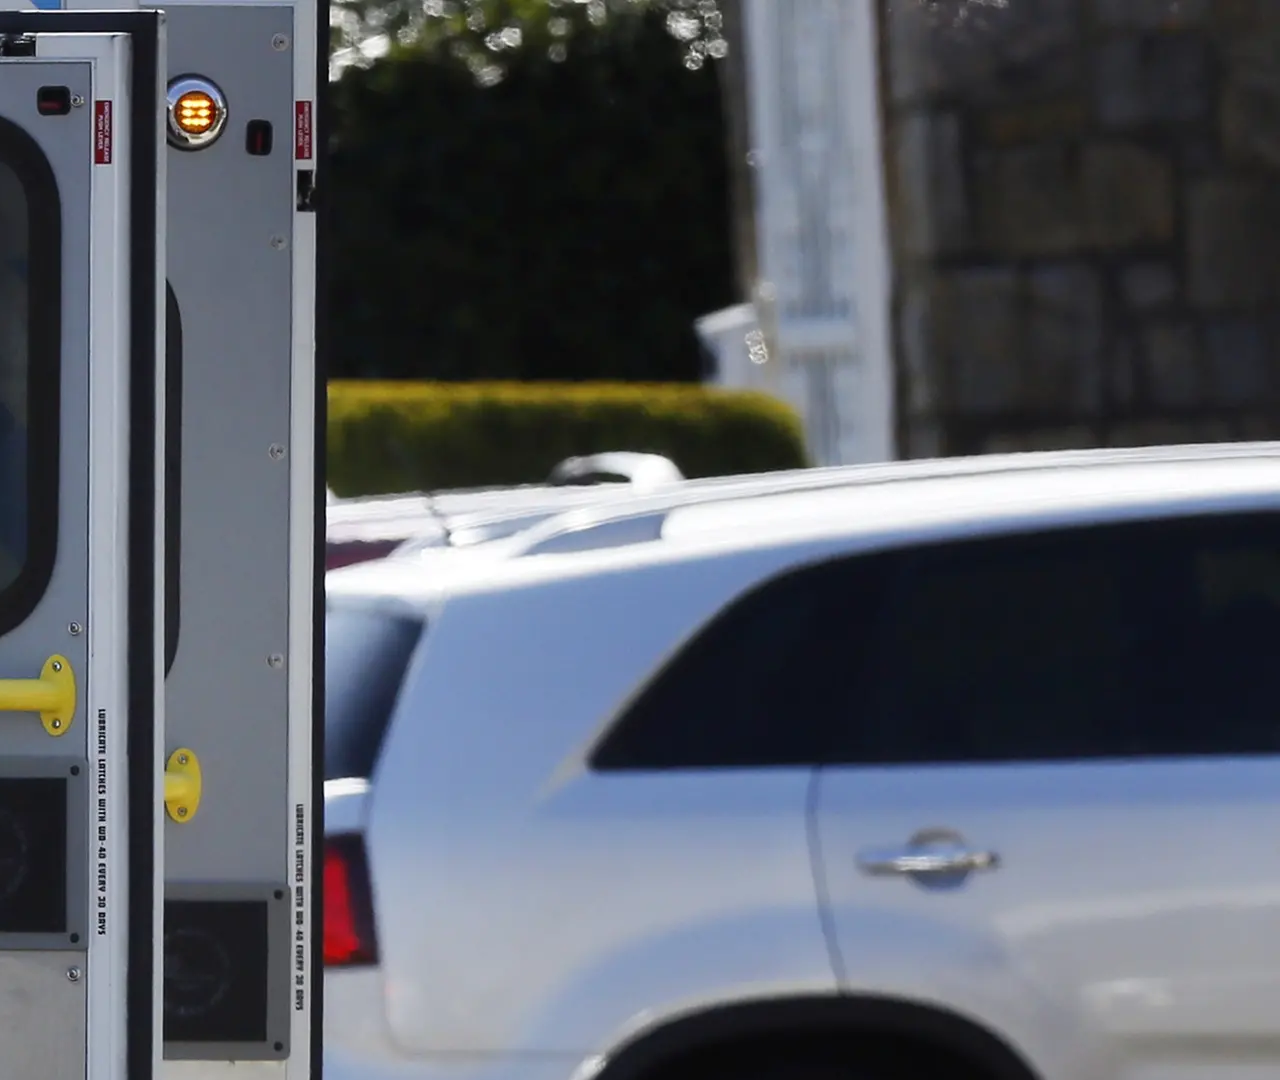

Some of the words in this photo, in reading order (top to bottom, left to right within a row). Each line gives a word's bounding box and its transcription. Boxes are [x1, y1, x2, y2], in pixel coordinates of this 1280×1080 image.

[98, 709, 106, 754] LUBRICATE
[98, 759, 106, 795] LATCHES
[98, 798, 106, 822] WITH
[98, 826, 106, 859] WD-40
[98, 863, 106, 892] EVERY
[98, 896, 106, 908] 30
[98, 912, 106, 935] DAYS
